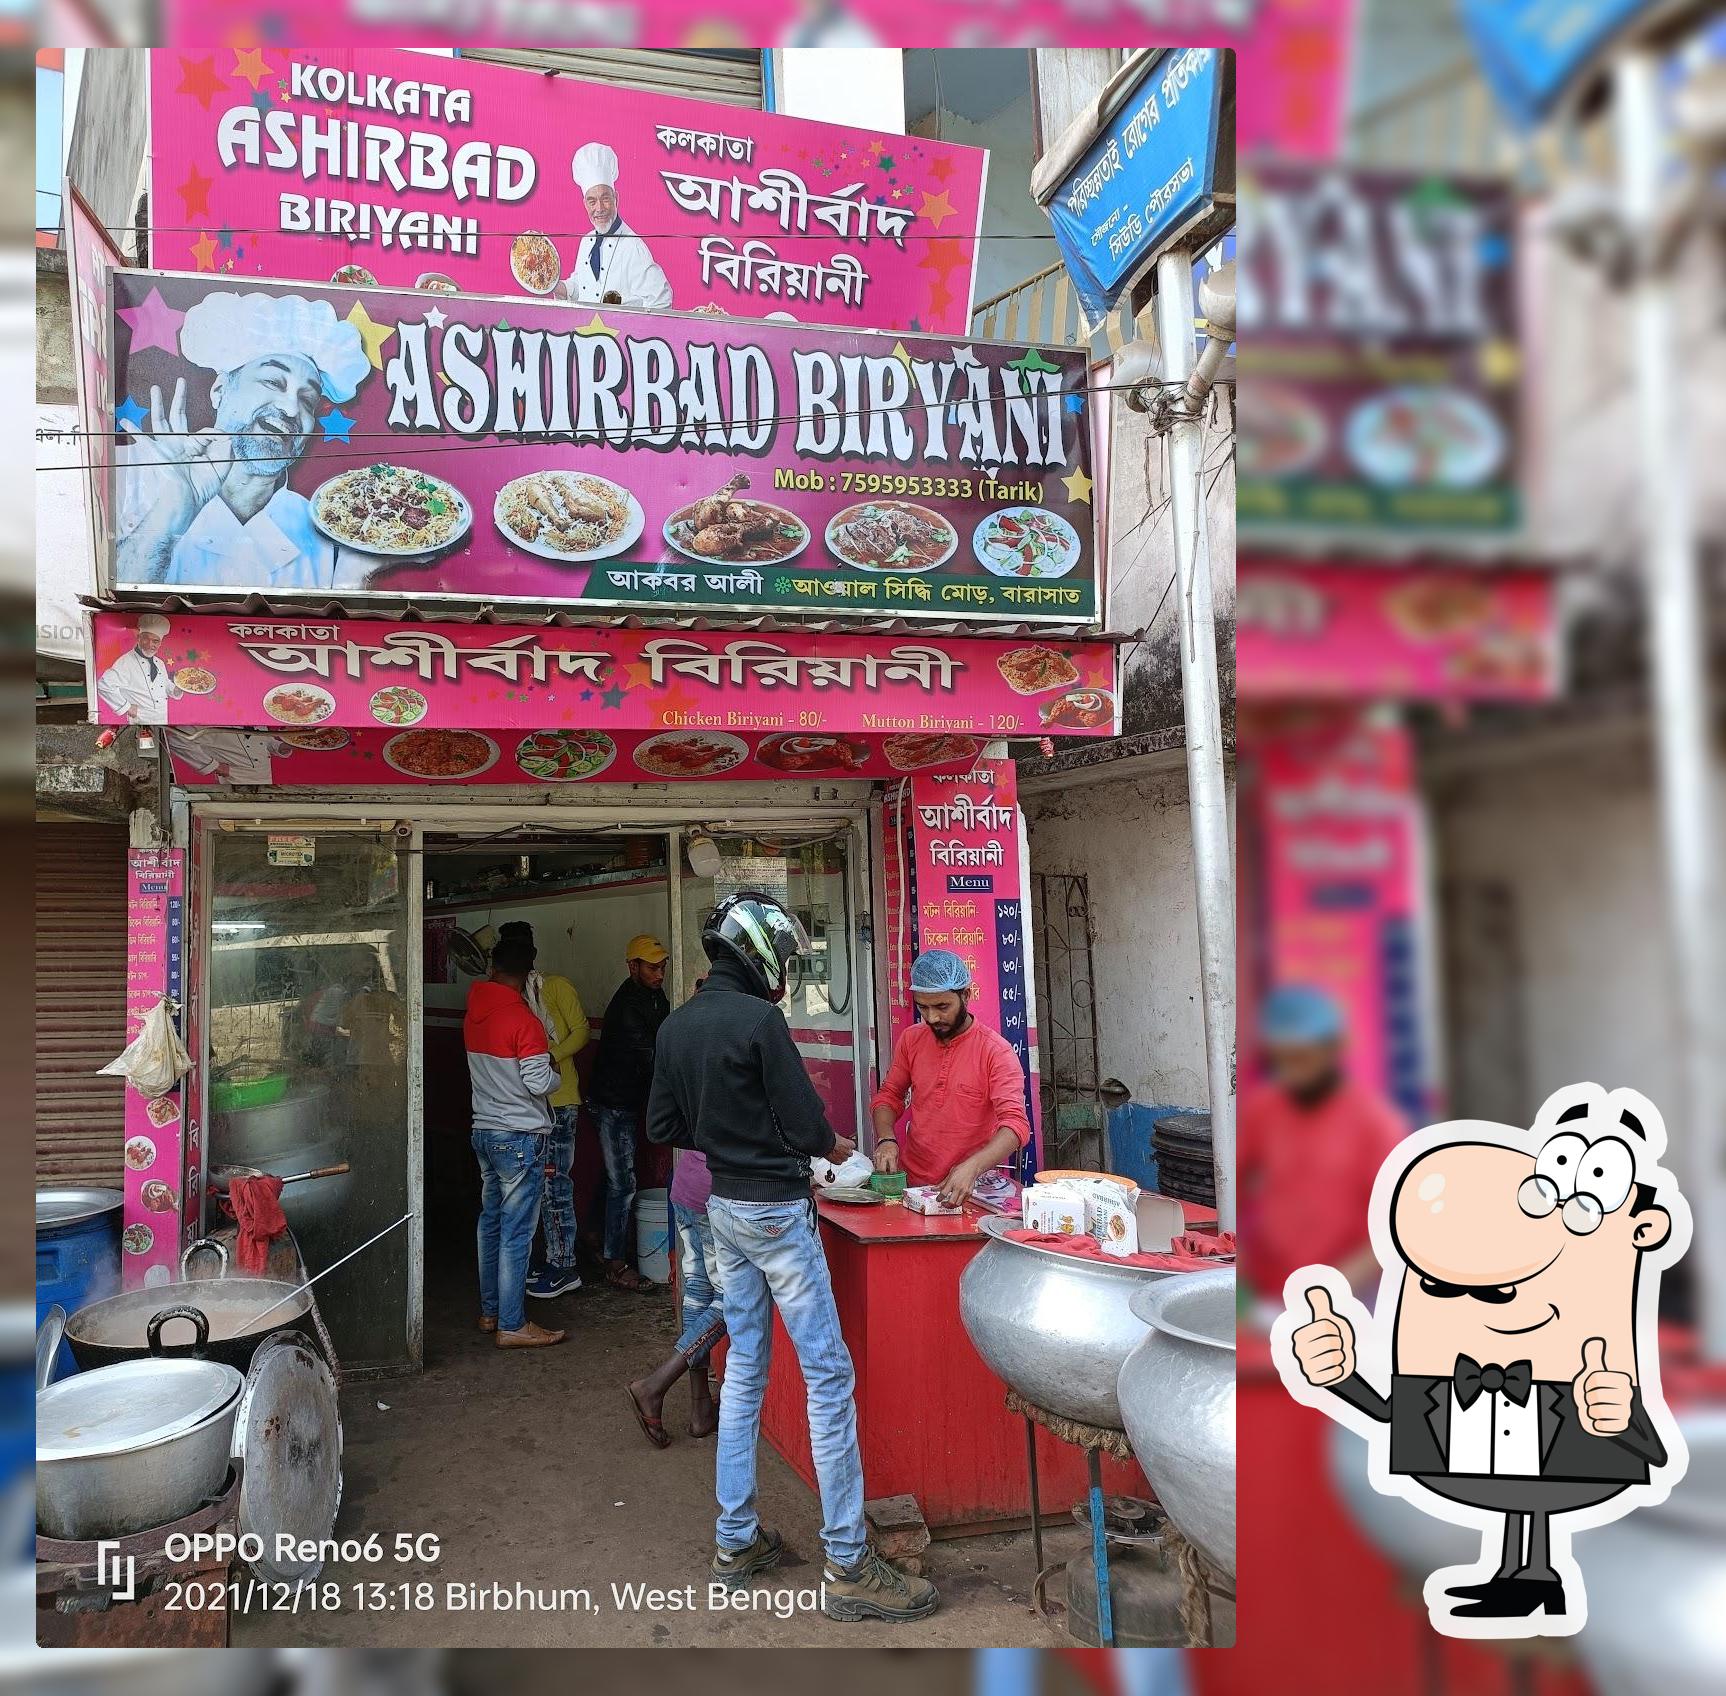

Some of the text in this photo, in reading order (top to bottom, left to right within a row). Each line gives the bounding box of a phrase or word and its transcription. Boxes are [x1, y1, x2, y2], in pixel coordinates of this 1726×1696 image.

[290, 62, 472, 123] KOLKATA
[656, 125, 754, 163] কলকাতা
[1122, 95, 1160, 159] রোগের
[217, 105, 537, 201] ASHIRBAD
[660, 169, 915, 247] আশীর্বাদ
[1145, 156, 1195, 224] পৌরসভা
[279, 193, 479, 256] BIRIYANI
[698, 237, 869, 305] বিরিয়ানী
[386, 320, 1068, 467] ASHIRBAD BIRYANI
[774, 468, 825, 491] Mob
[840, 471, 973, 498] 7595953333
[977, 478, 1044, 503] (Tarik)
[607, 568, 696, 594] আকবর
[703, 569, 764, 596] আলী
[1001, 583, 1081, 607] বারাসাত
[227, 623, 340, 643] কলকাতা
[240, 630, 964, 690] আশীর্বাদ বিরিয়ানী
[662, 710, 722, 727] Chicken
[726, 711, 784, 730] Biriyani
[798, 710, 828, 728] 80/-
[862, 714, 916, 730] Mutton
[920, 715, 975, 732] Biriyani
[988, 714, 1024, 732] 120/-
[918, 794, 1013, 831] আশীর্বাদ
[929, 840, 1004, 867] বিরিয়ানী
[950, 876, 990, 887] Menu
[924, 927, 949, 946] চিকেন
[1003, 957, 1022, 974] ৬০/-
[1003, 984, 1022, 1001] ৫৫/-
[1006, 1012, 1024, 1029] ৮০/-
[1013, 1040, 1026, 1057] ০/-
